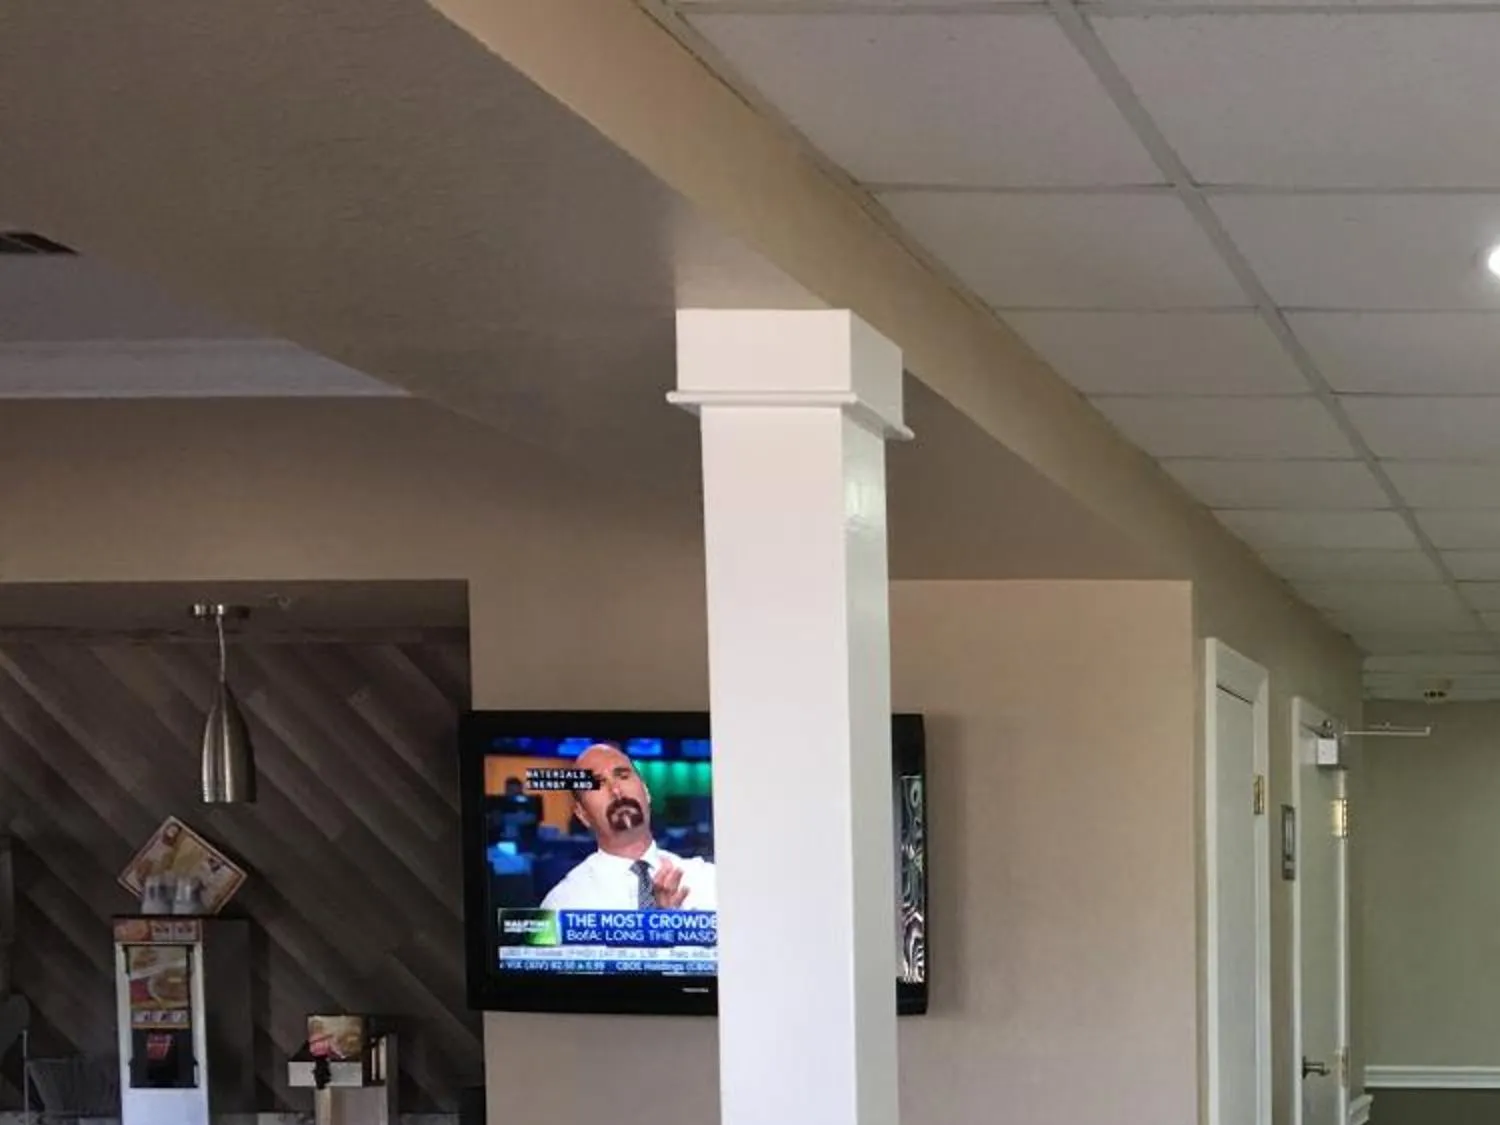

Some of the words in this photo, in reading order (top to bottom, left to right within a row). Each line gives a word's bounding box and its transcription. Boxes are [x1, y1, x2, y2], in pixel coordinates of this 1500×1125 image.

[566, 913, 597, 928] THE
[601, 913, 643, 928] MOST
[605, 929, 645, 941] LONG
[649, 929, 675, 941] THE
